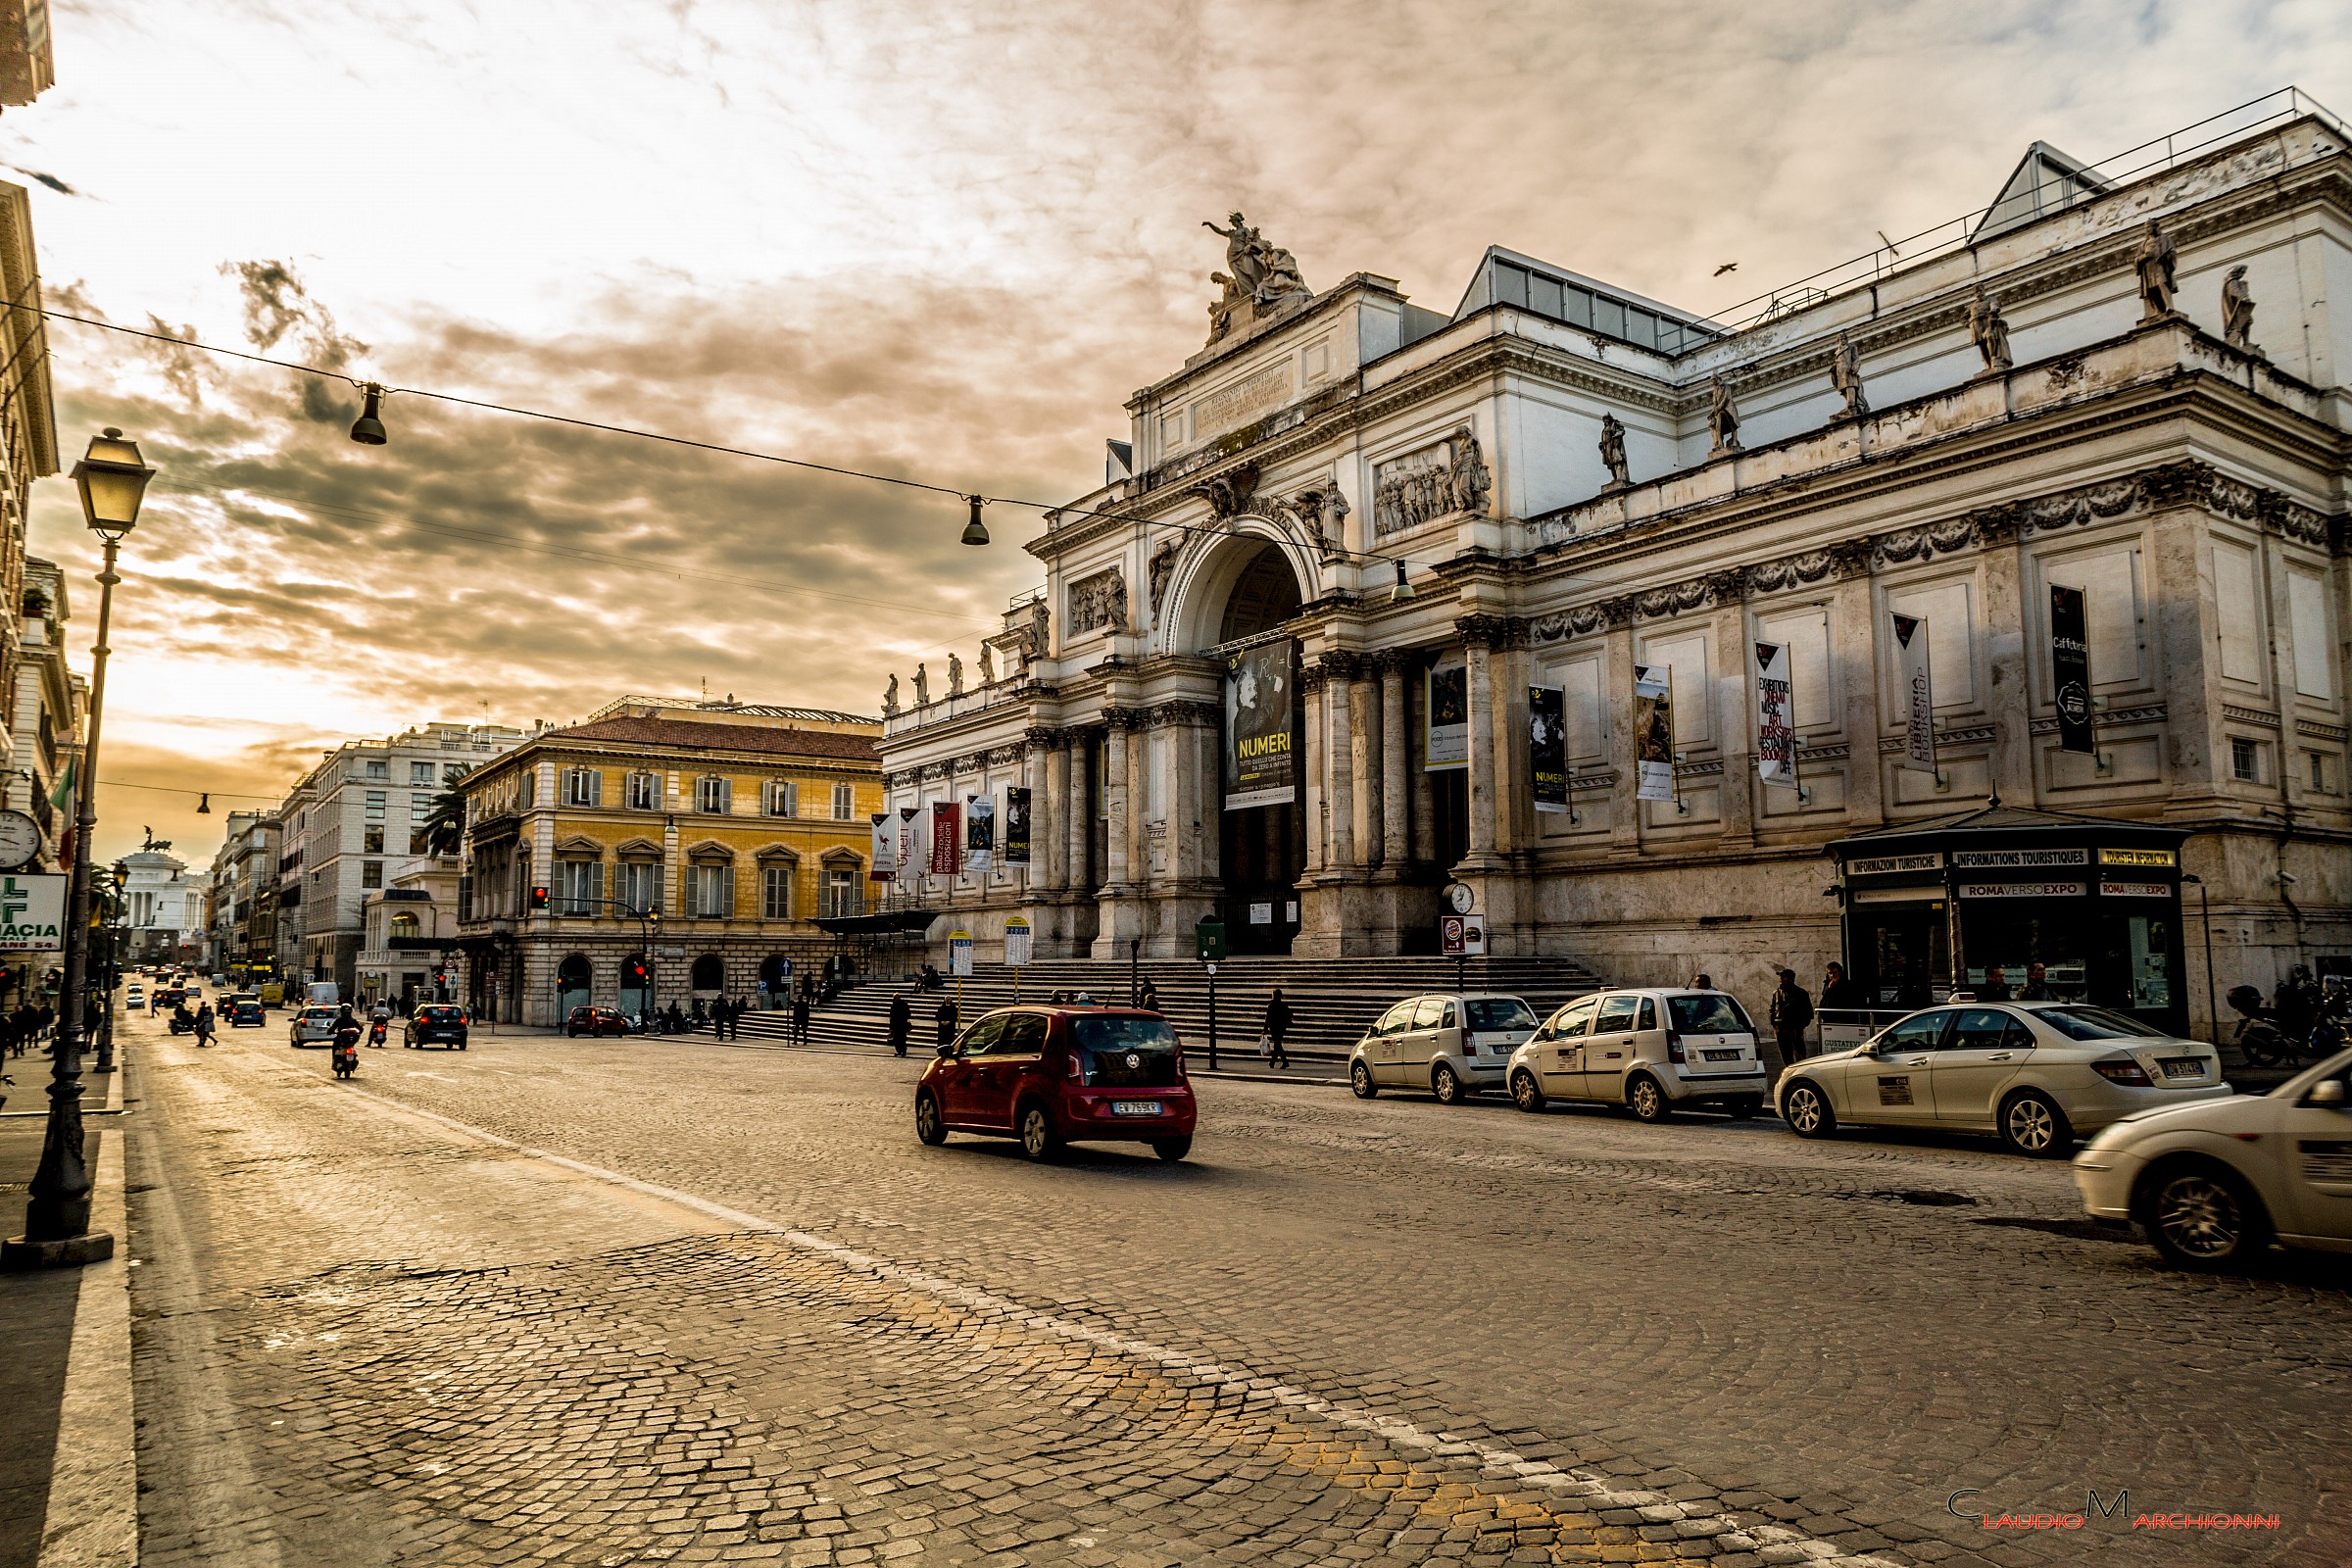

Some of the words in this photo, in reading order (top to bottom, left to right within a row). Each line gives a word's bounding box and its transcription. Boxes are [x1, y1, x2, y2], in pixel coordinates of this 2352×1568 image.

[1759, 677, 1789, 694] EXHIBITIONS
[1769, 713, 1782, 726] ART
[1912, 677, 1922, 760] LIBRERIA
[1917, 667, 1930, 762] BOOKSHOP
[1239, 732, 1291, 759] NUMERI
[1762, 748, 1790, 761] BOOKSHOP
[1536, 772, 1565, 784] NUMERI
[900, 829, 911, 866] open
[944, 822, 953, 873] esposizioni
[1854, 858, 1896, 873] INFORMAZIONI
[1898, 856, 1935, 870] TURISTICHE
[1957, 852, 2019, 866] INFORMATIONS
[2021, 851, 2084, 864] TOURISTIQUES
[2106, 850, 2133, 864] TOURISTEN
[2135, 851, 2168, 864] INFORMATION
[0, 924, 58, 936] ACIA
